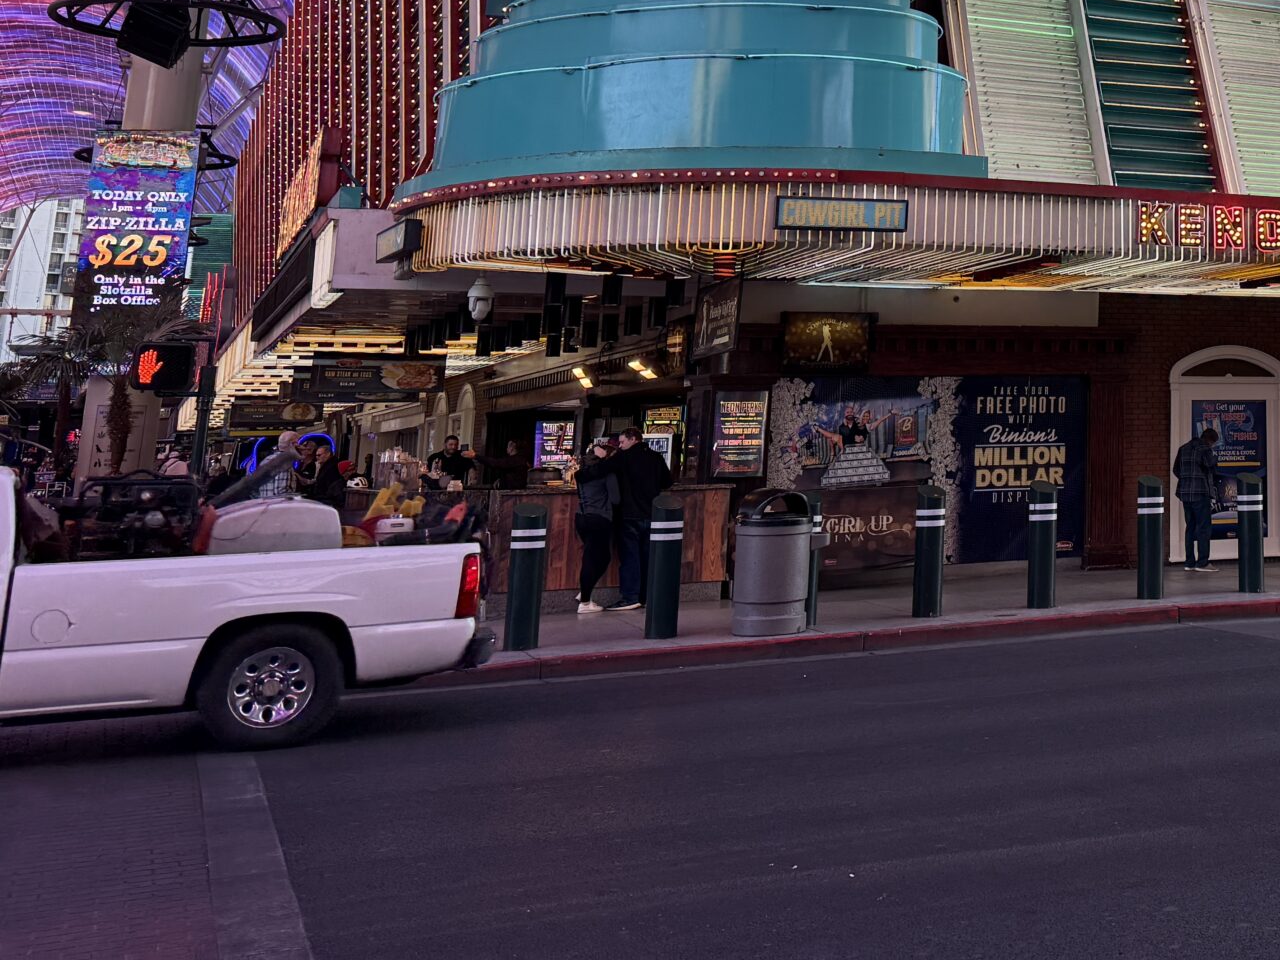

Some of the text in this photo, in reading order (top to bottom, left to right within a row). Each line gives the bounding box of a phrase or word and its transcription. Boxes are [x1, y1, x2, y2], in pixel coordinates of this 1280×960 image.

[92, 190, 189, 202] TODAY ONLY
[145, 202, 168, 213] 4pm
[783, 200, 903, 228] COWGIRL PIT
[86, 217, 186, 231] ZIP-ZILLA
[94, 274, 165, 286] Only in the
[100, 286, 153, 295] Slotzilla
[93, 296, 117, 305] Box
[993, 386, 1049, 395] TAKE YOUR
[720, 401, 740, 413] NEON
[976, 396, 1066, 414] FREE PHOTO
[1216, 403, 1228, 411] Get
[1228, 404, 1246, 412] your
[1008, 415, 1033, 424] WITH
[983, 424, 1058, 443] Binion's
[974, 446, 1066, 467] MILLION
[975, 467, 1065, 488] DOLLAR
[869, 515, 894, 532] UP
